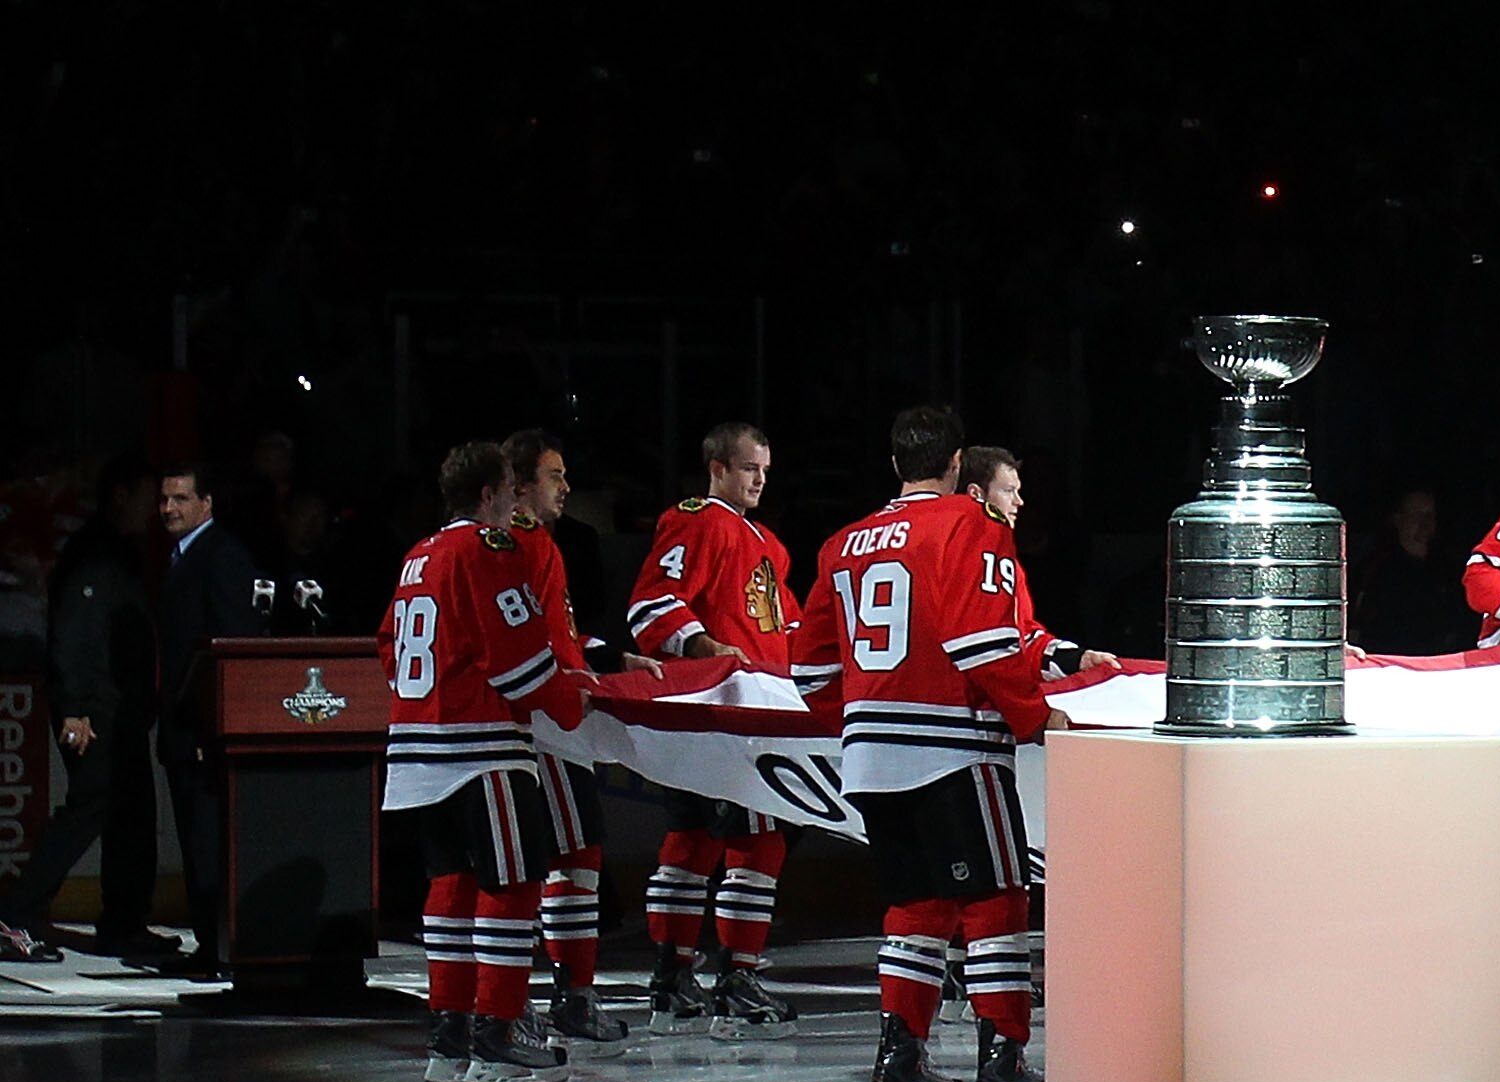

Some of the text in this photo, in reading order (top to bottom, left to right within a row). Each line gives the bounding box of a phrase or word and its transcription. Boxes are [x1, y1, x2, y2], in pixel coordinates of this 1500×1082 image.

[840, 521, 911, 557] TOEWS
[659, 545, 685, 580] 4
[981, 552, 1016, 596] 19
[831, 561, 912, 671] 19
[0, 683, 34, 881] Reebok
